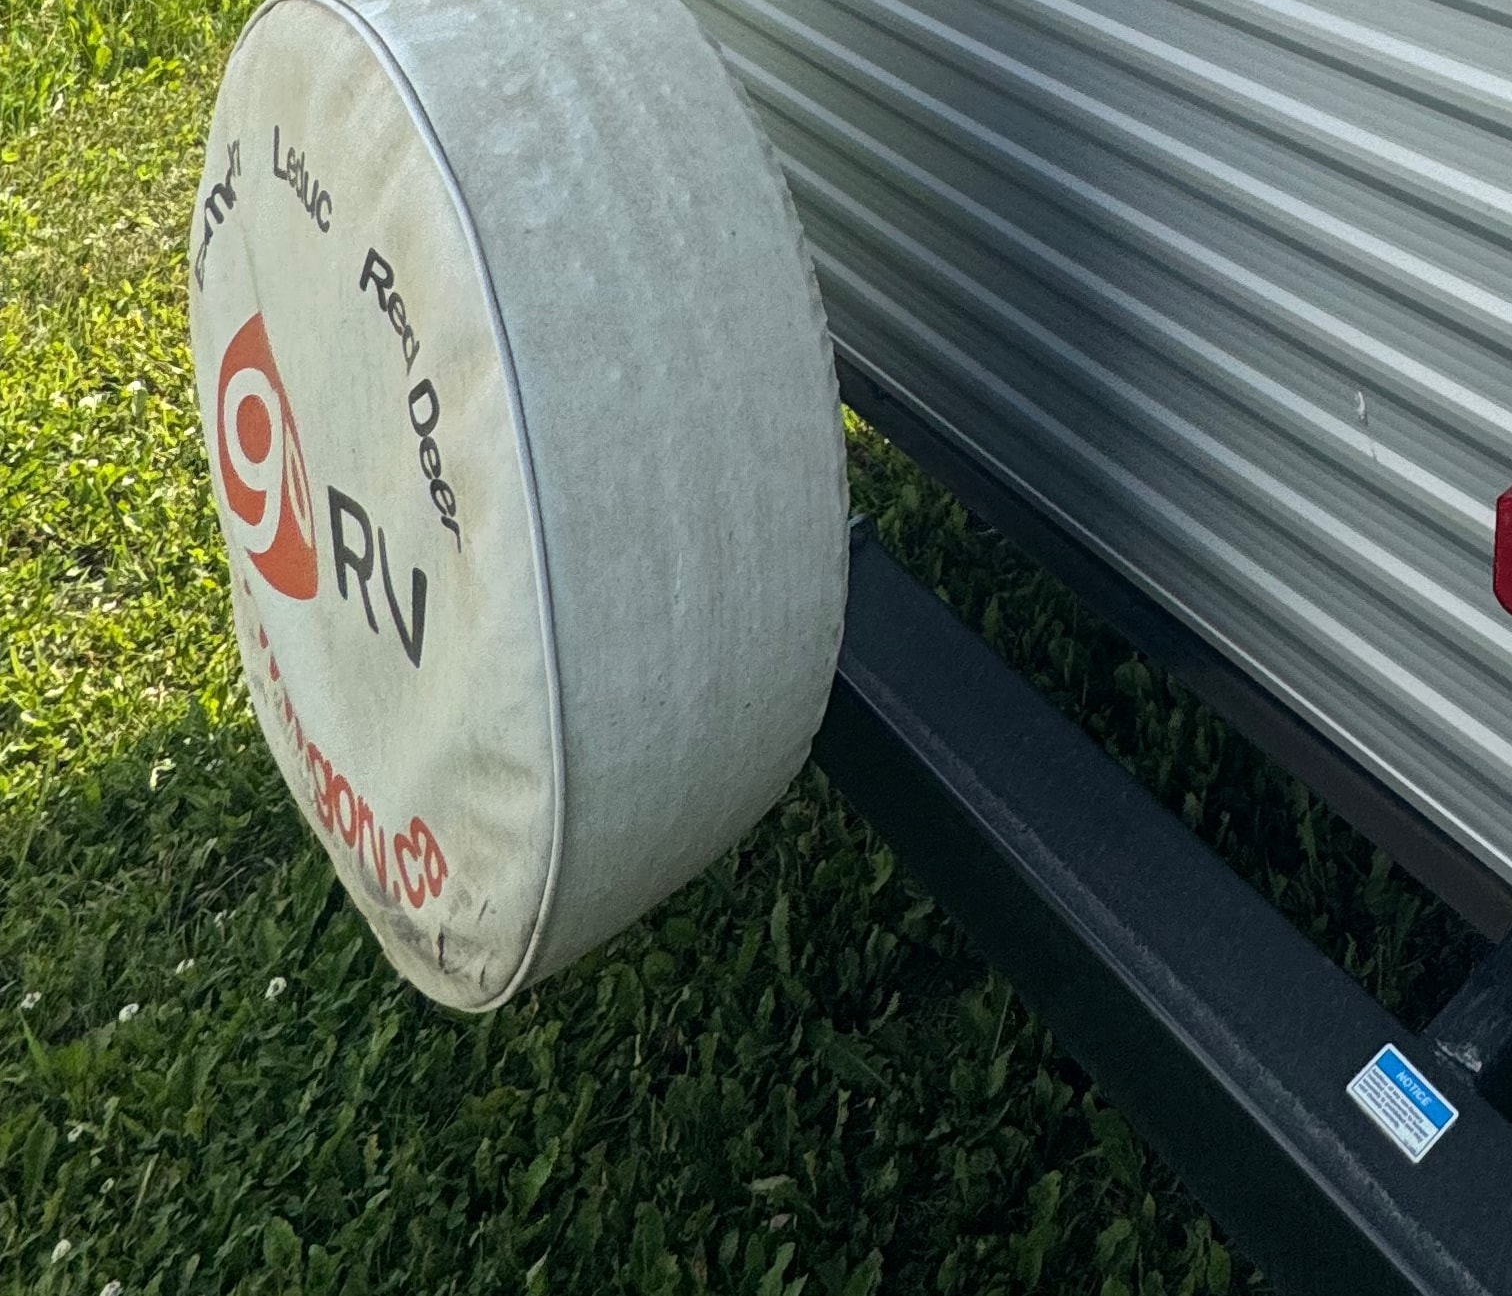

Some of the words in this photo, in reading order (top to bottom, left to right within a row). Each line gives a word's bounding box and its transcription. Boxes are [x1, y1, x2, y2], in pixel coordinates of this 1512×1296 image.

[359, 247, 420, 376] Red
[407, 377, 462, 554] Deer
[327, 484, 428, 669] RV
[1395, 1068, 1434, 1108] NOTICE
